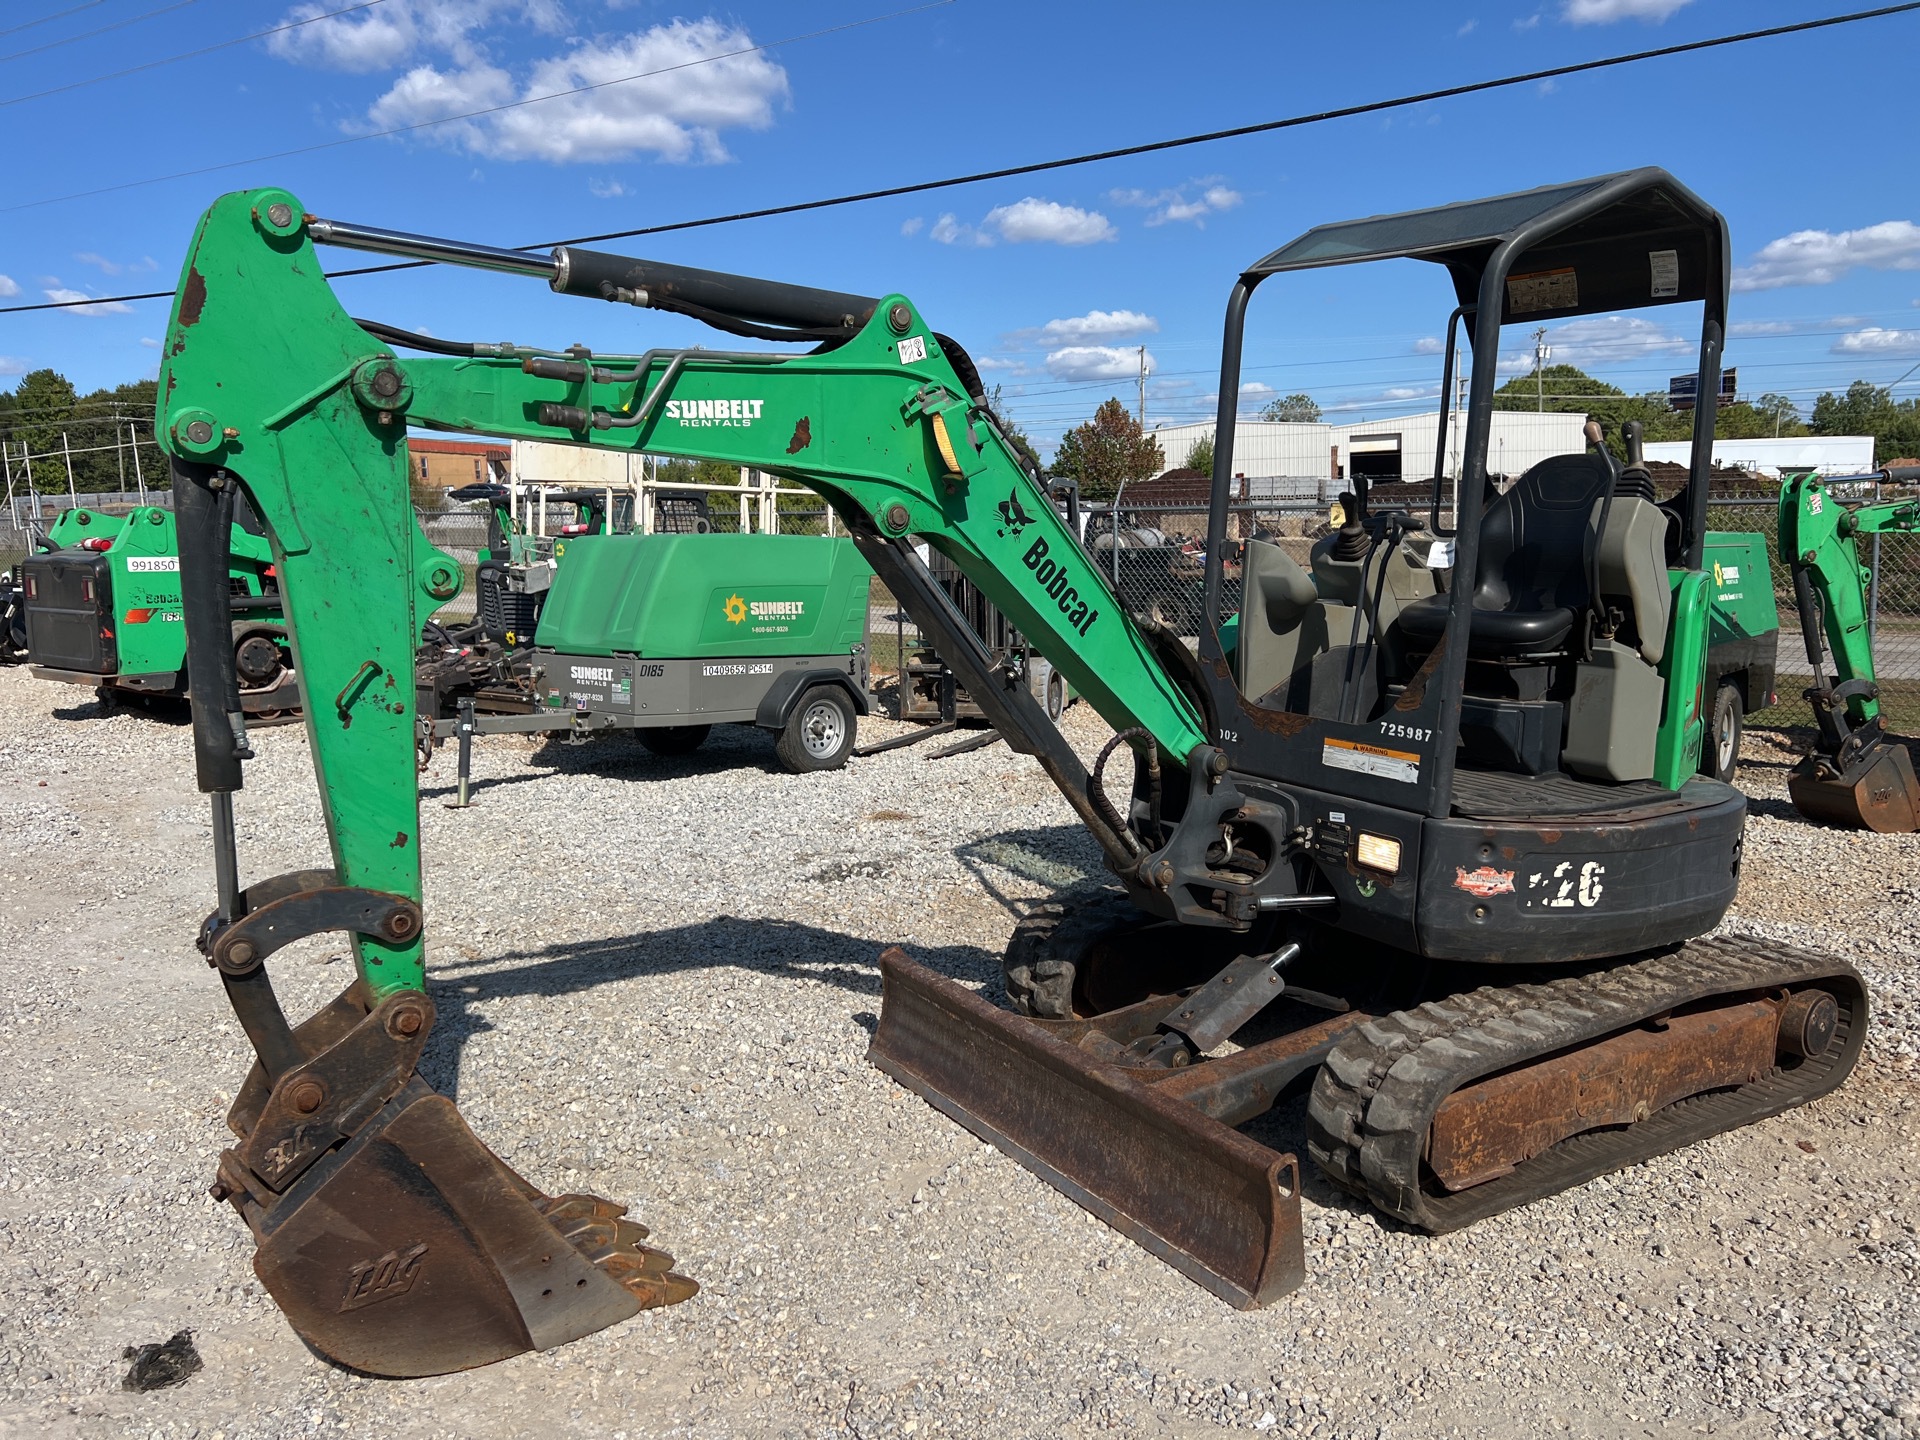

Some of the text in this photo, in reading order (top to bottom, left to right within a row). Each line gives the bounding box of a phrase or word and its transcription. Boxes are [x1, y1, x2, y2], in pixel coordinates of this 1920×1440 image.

[665, 399, 764, 419] SUNBELT
[680, 419, 751, 427] RENTALS
[131, 561, 175, 571] 991850
[1022, 536, 1099, 638] Bobcat
[750, 602, 804, 615] SUNBELT
[570, 665, 614, 682] SUNBELT
[640, 664, 665, 677] D185
[703, 664, 773, 676] 10409652 PC514
[1379, 721, 1432, 743] 725987
[1360, 744, 1389, 756] WARNING
